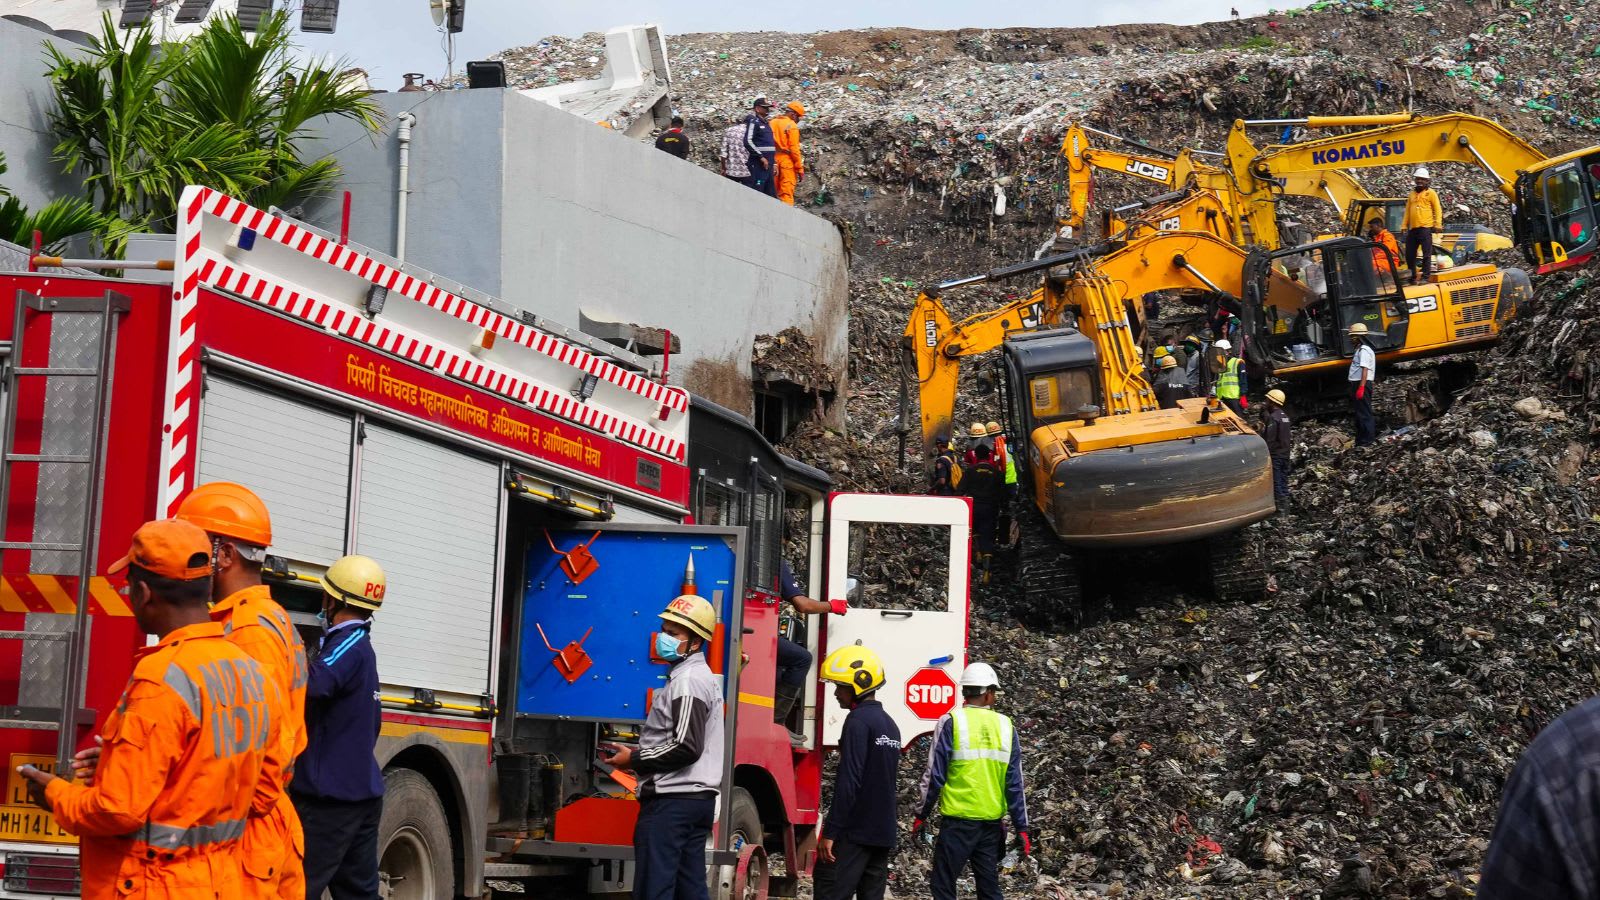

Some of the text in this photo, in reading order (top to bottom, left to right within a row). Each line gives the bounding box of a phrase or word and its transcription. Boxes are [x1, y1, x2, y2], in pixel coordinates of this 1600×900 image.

[1312, 139, 1405, 165] KOMATSU
[1125, 160, 1169, 181] JCB
[1159, 216, 1180, 235] JCB
[925, 320, 938, 348] 205
[346, 353, 376, 393] पिंपरी
[378, 364, 419, 406] चिंचवड
[419, 386, 489, 430] महानगरपालिका
[531, 426, 541, 447] व
[584, 438, 601, 469] सेवा
[670, 598, 694, 615] IRE
[908, 684, 954, 704] STOP
